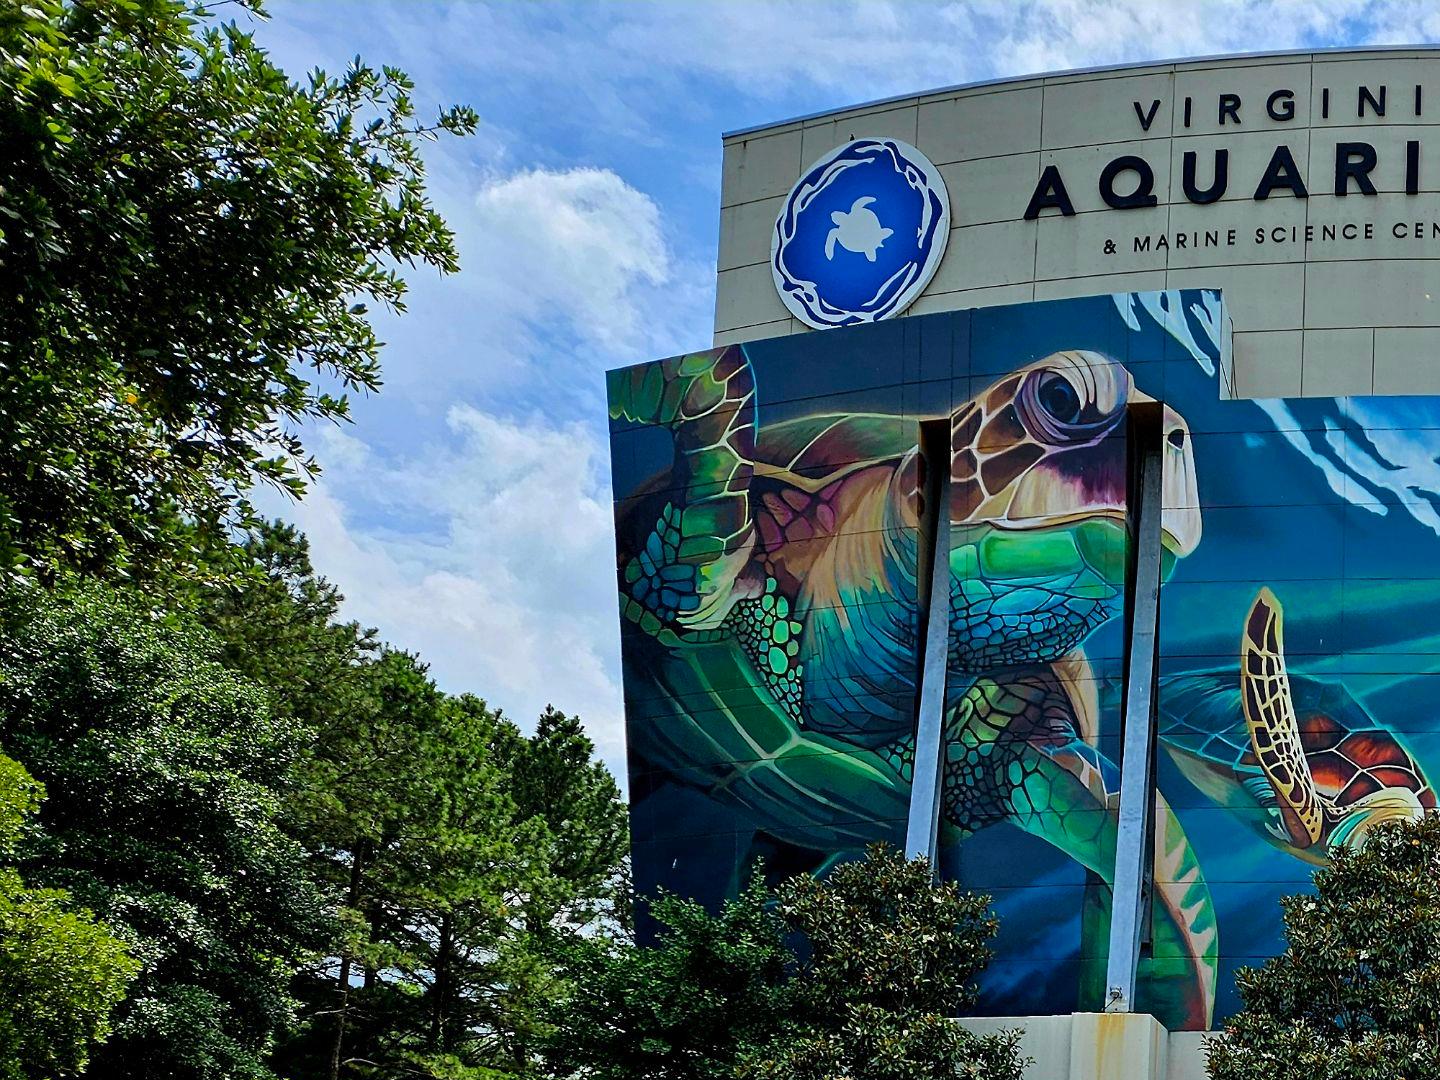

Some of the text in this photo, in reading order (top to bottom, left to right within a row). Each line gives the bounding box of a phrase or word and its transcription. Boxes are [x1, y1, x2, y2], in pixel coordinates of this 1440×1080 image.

[1103, 239, 1117, 255] &
[1133, 229, 1237, 253] MARINE
[1255, 223, 1374, 244] SCIENCE
